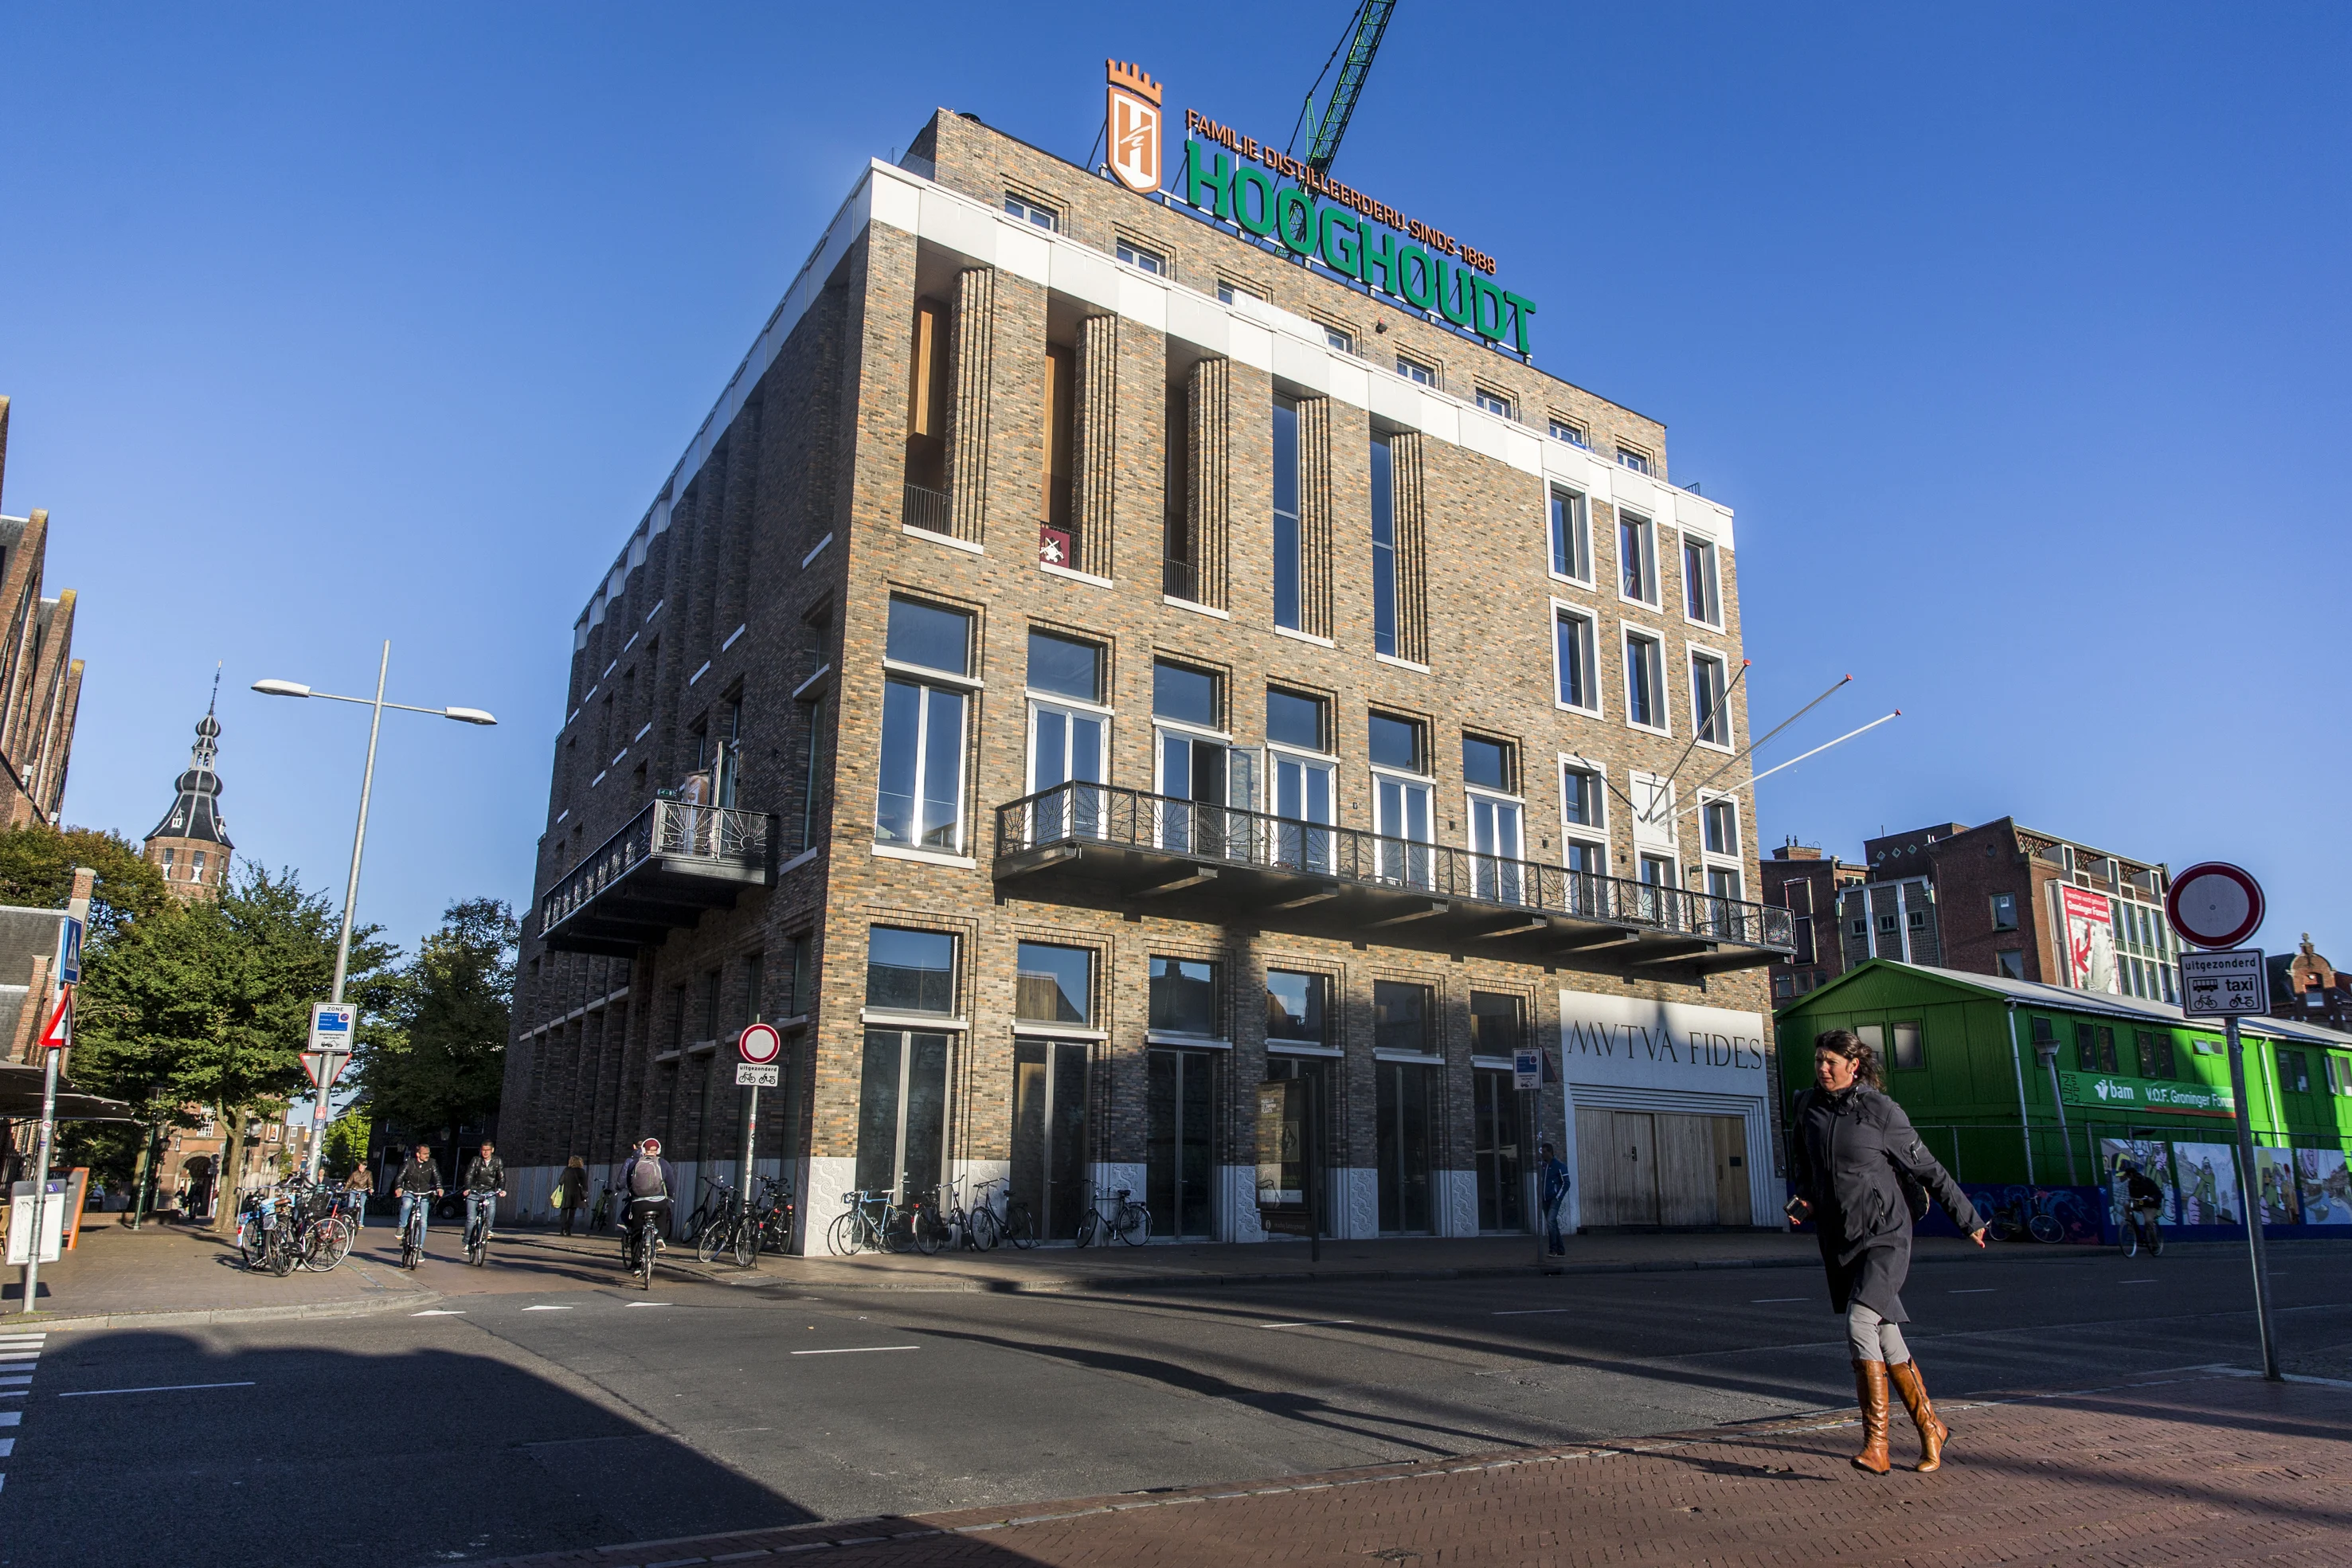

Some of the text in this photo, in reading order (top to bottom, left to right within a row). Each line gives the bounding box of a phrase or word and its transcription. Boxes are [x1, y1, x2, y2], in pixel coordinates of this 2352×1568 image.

[1186, 108, 1497, 275] FAMILIE DISTILLEERDERIJ SINDS 1888
[1185, 139, 1536, 355] HOOGHOUDT
[2067, 900, 2109, 918] Groninger Forum
[2186, 958, 2256, 972] uitgezonderd
[2225, 977, 2254, 992] taxi
[1568, 1020, 1763, 1069] MVTVA FIDES
[2110, 1080, 2135, 1100] bam
[2145, 1087, 2169, 1103] V.O.F.
[2170, 1089, 2210, 1108] Groninger
